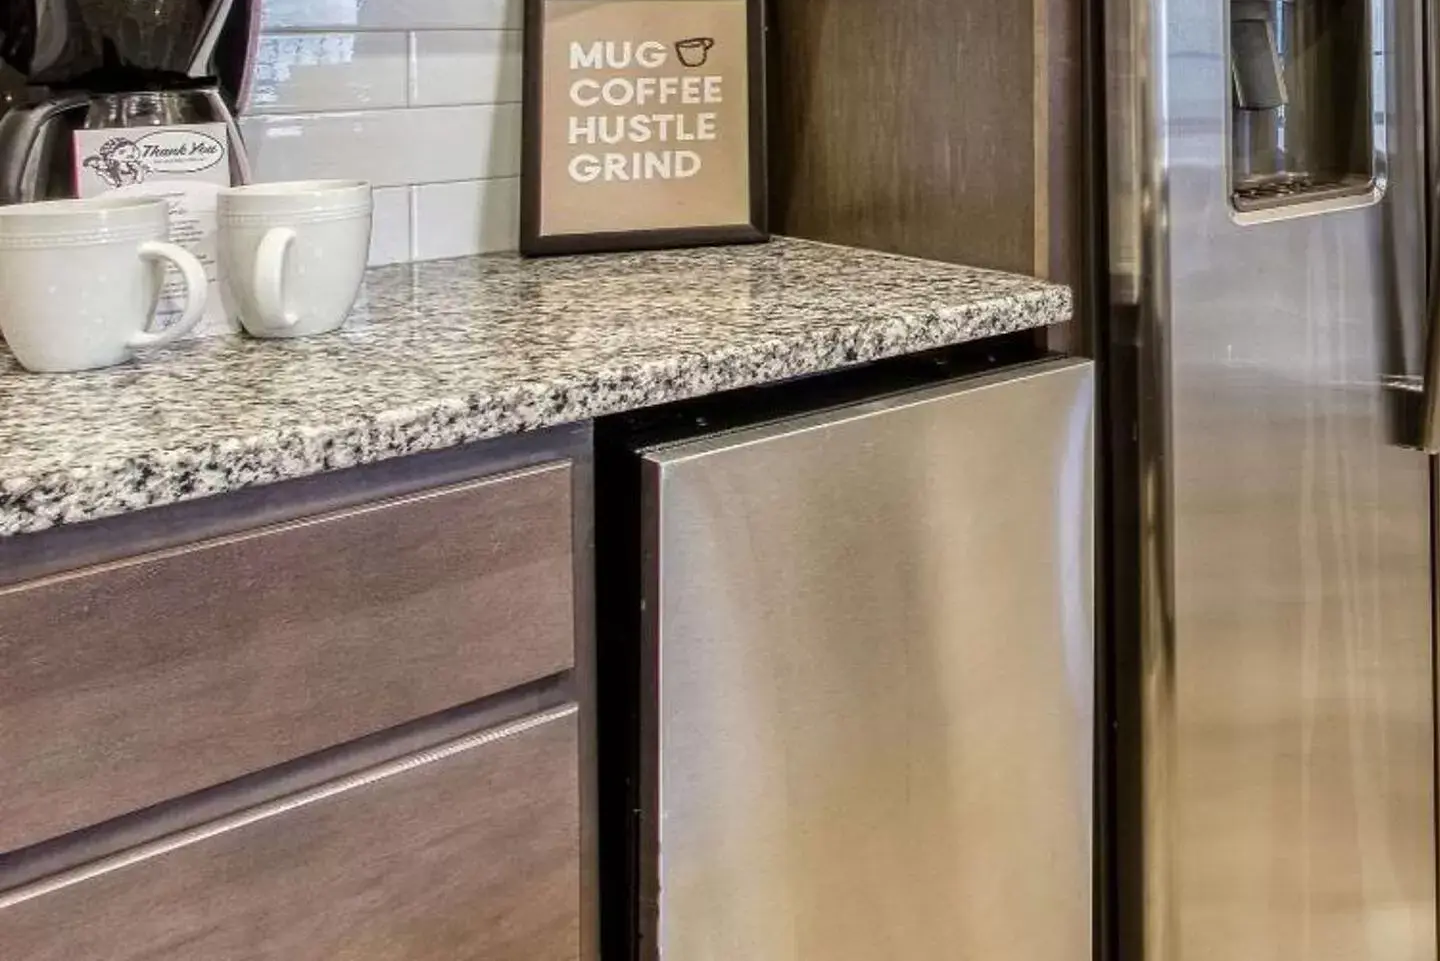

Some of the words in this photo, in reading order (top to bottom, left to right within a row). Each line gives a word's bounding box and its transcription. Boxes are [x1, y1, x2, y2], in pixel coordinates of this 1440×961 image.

[568, 40, 669, 70] MUG
[568, 75, 723, 107] COFFEE
[567, 112, 717, 145] HUSTLE
[142, 144, 187, 157] Thank
[188, 141, 217, 156] You
[567, 150, 702, 183] GRIND
